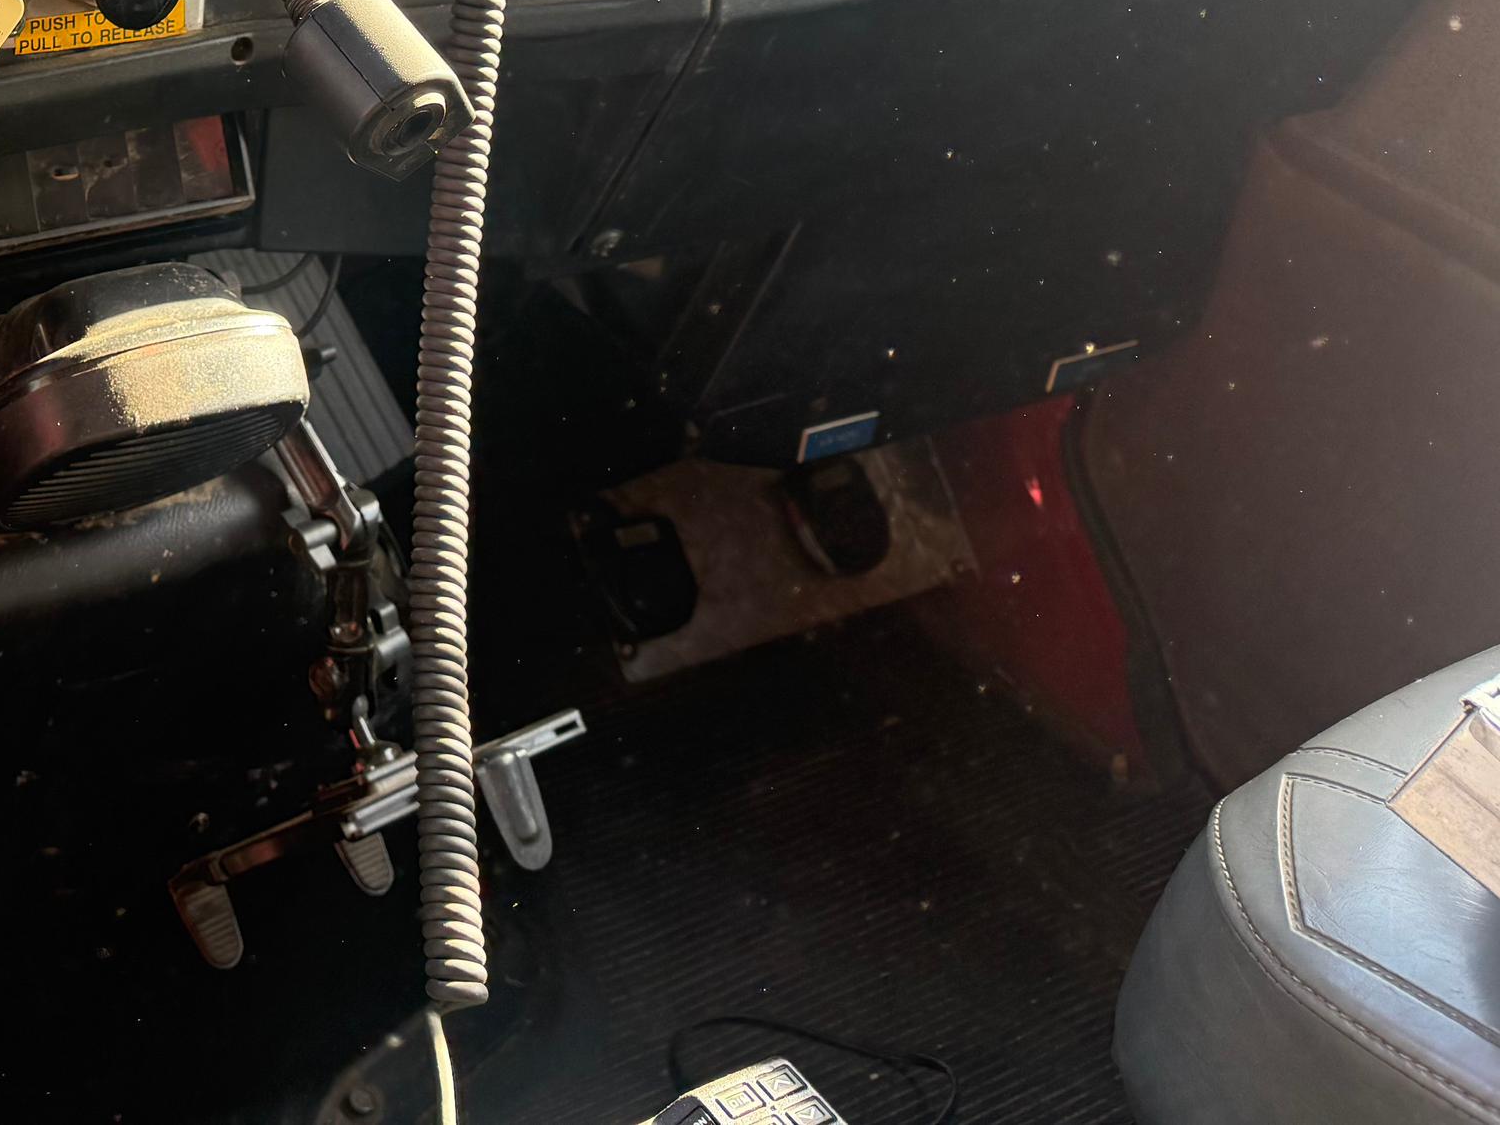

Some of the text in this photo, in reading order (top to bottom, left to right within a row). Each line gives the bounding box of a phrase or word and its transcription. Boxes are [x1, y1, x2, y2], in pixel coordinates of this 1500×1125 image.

[30, 13, 106, 34] PUSH TO
[19, 36, 61, 53] PULL
[71, 31, 92, 45] TO
